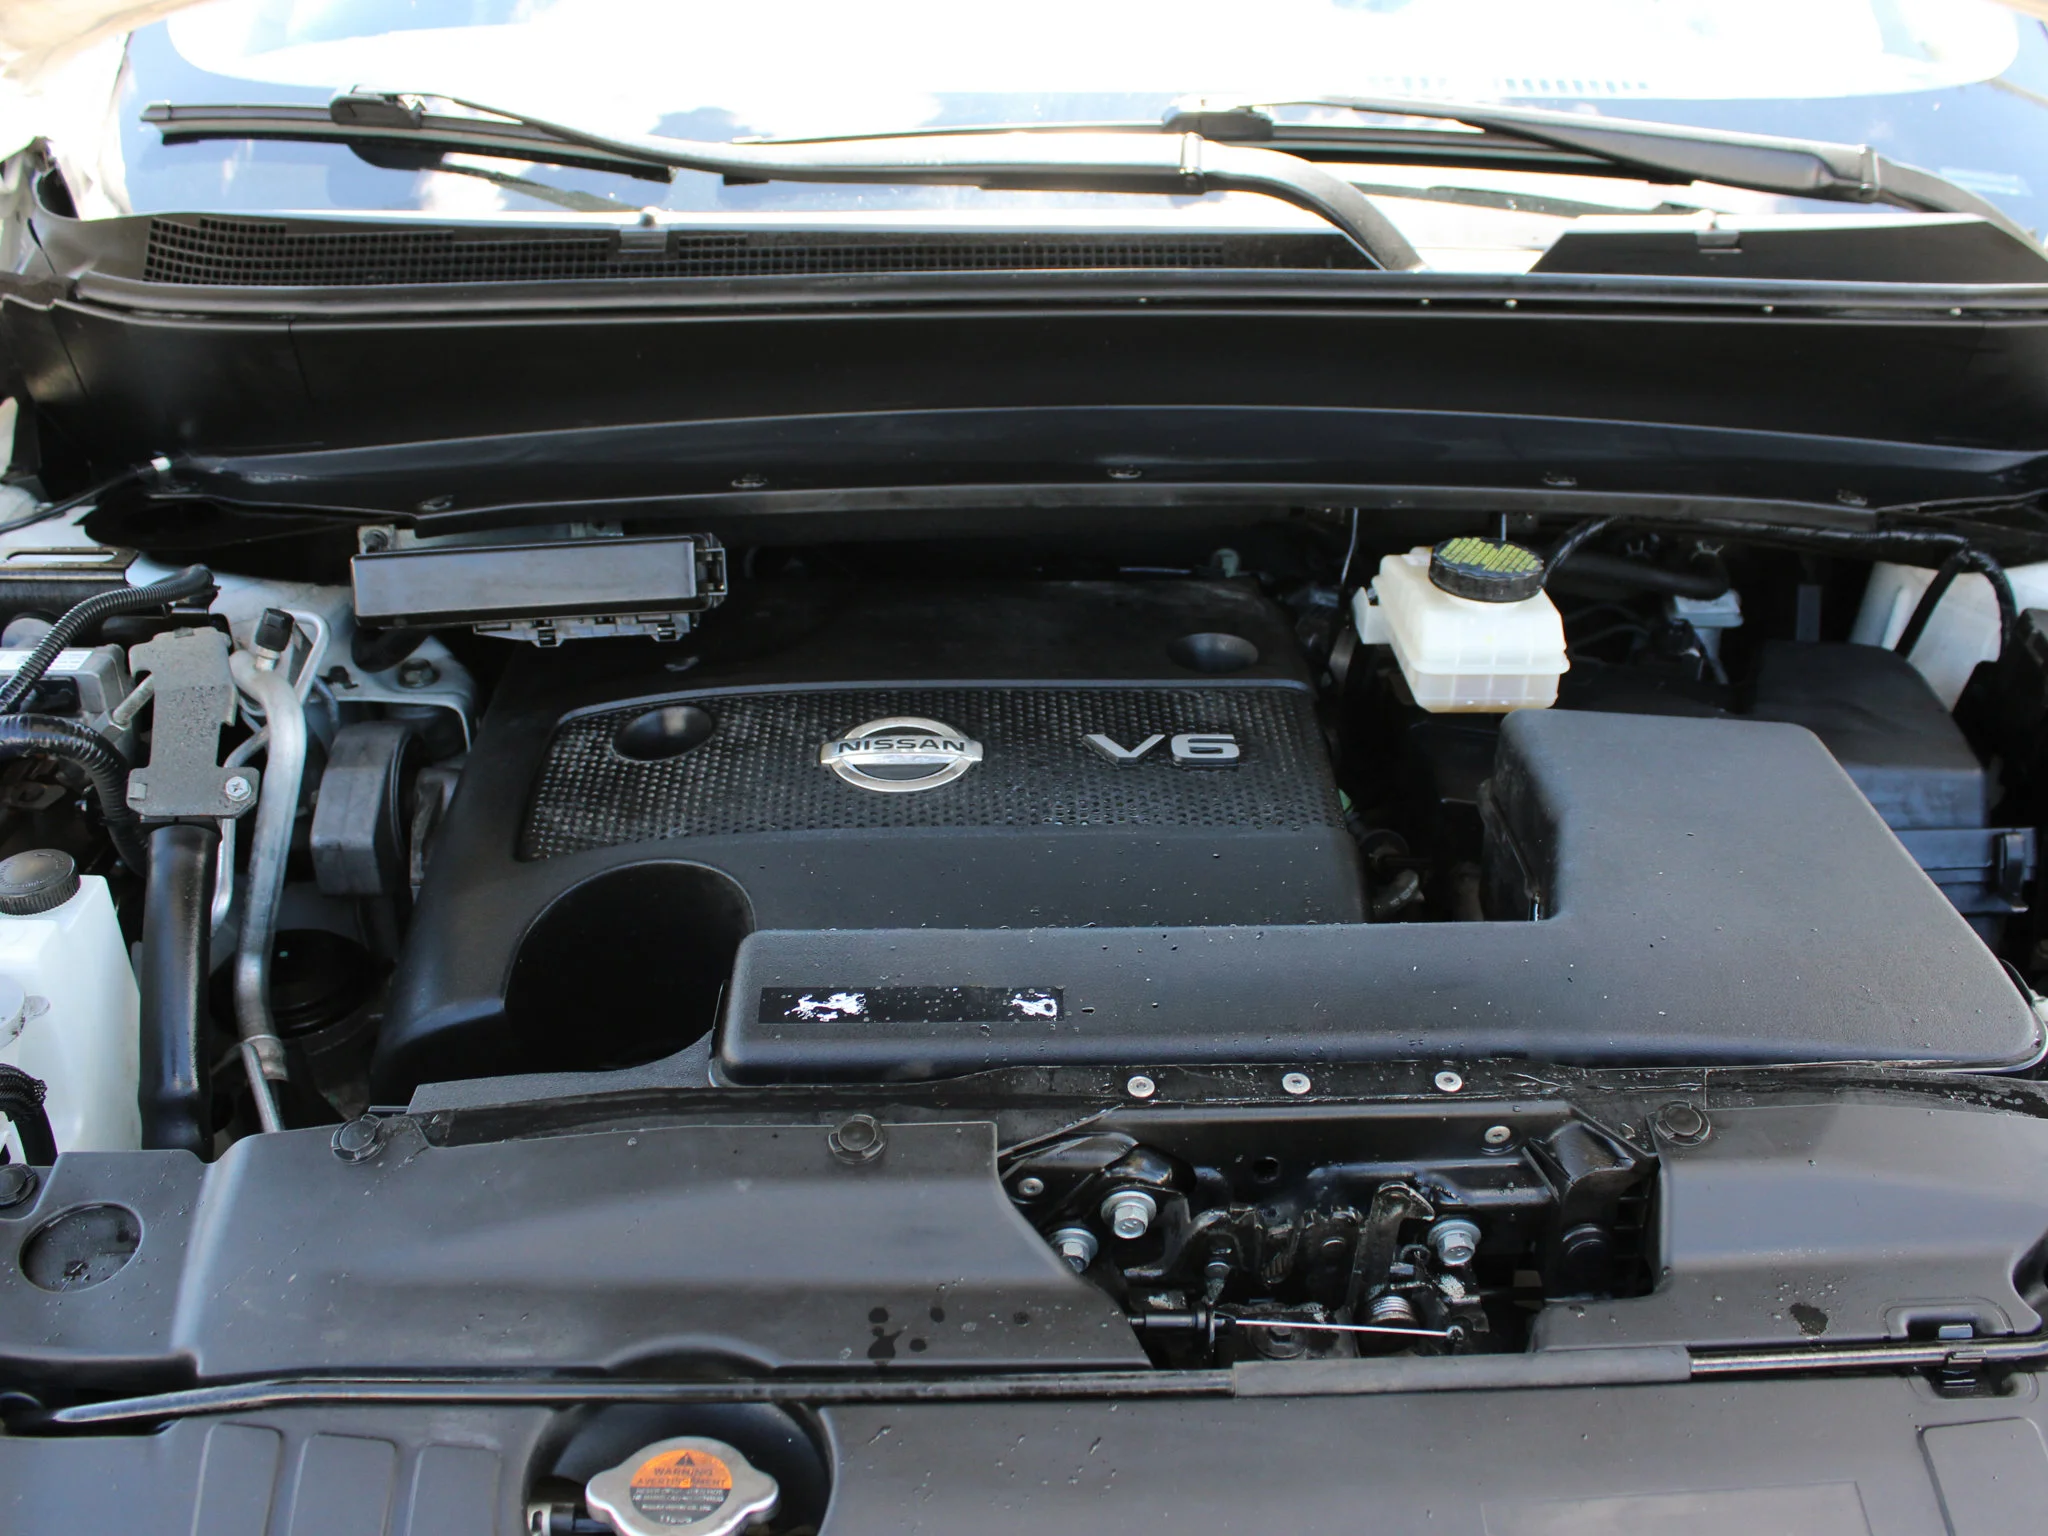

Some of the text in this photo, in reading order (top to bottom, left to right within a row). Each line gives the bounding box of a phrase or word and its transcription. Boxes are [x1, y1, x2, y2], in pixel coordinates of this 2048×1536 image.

[838, 738, 965, 753] NISSAN
[1080, 733, 1240, 768] V6
[654, 1467, 713, 1476] WARNING
